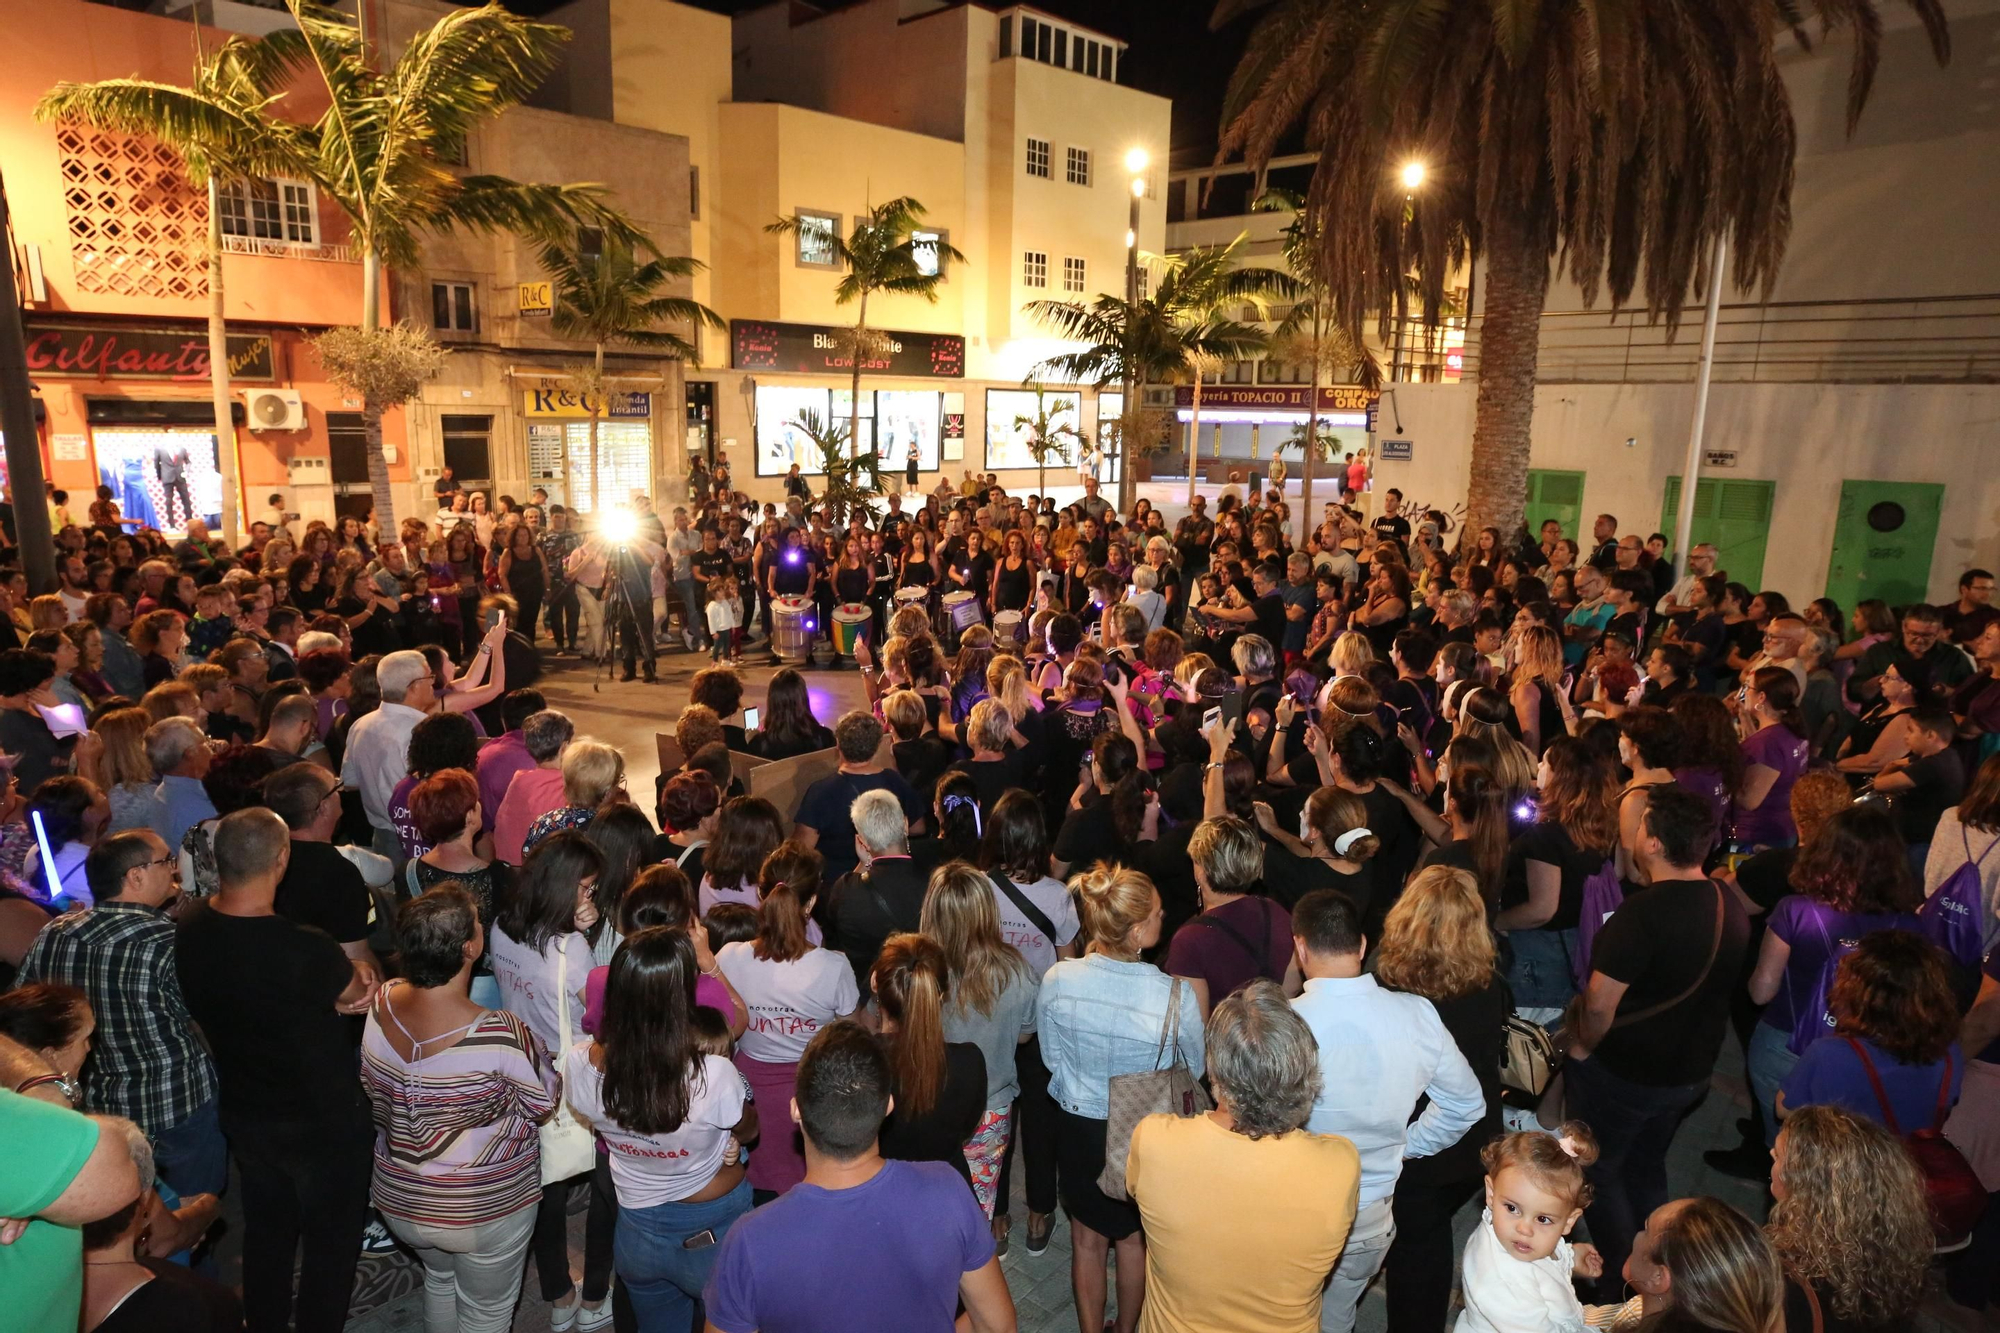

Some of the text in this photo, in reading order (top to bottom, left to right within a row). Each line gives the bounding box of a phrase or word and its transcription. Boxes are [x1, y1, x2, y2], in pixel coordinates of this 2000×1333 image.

[1231, 392, 1286, 404] TOPACIO
[1290, 393, 1302, 404] II
[1325, 388, 1380, 399] COMPRO
[1335, 398, 1368, 409] ORO
[393, 805, 411, 819] SOM
[999, 920, 1027, 928] otras
[1001, 931, 1043, 948] TAS
[749, 1005, 796, 1013] nosotras
[747, 1016, 817, 1035] UNTAS
